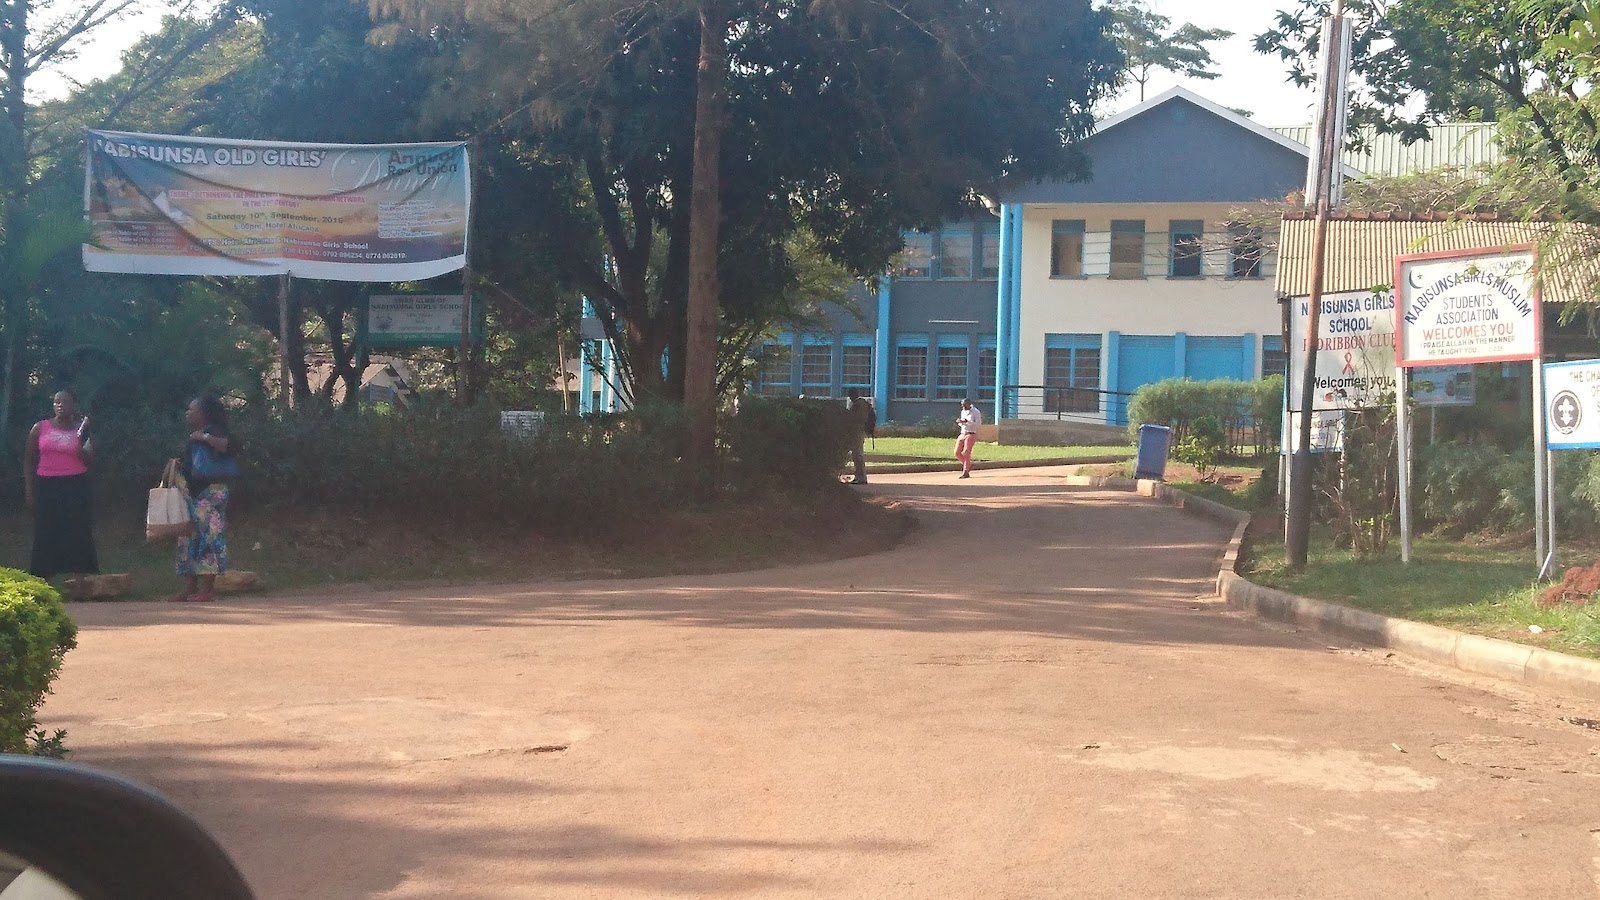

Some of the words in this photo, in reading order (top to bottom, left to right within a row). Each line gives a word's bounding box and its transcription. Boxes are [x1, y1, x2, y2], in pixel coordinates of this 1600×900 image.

[213, 148, 257, 166] OLD
[262, 149, 326, 168] GIRLS'
[206, 213, 246, 221] Saturday
[343, 242, 369, 250] School
[1404, 272, 1463, 325] NABISUNSA
[1463, 268, 1495, 287] GIRLS
[1492, 277, 1533, 319] MUSLIM
[1329, 317, 1372, 333] SCHOOL
[1436, 308, 1500, 326] ASSOCIATION
[1423, 325, 1487, 341] WELCOMES
[1490, 322, 1514, 336] YOU
[1325, 335, 1366, 351] RIBBON
[1423, 341, 1445, 349] PRAISE
[1446, 340, 1467, 348] ALLAH
[1488, 336, 1515, 344] MANNER
[1437, 347, 1463, 356] TAUGHT
[1569, 371, 1583, 383] THE
